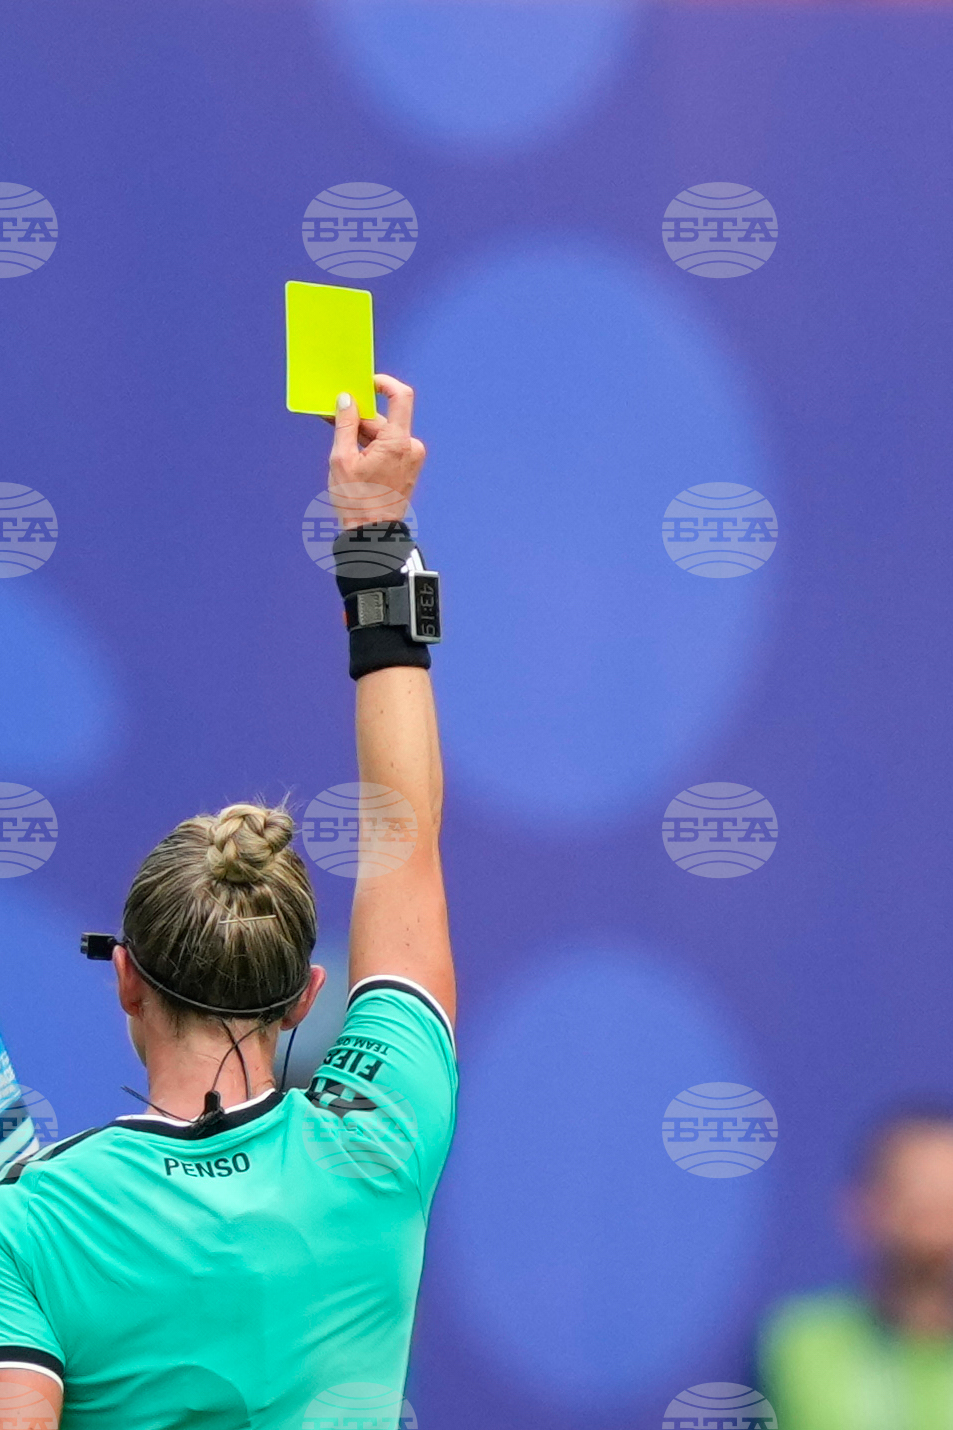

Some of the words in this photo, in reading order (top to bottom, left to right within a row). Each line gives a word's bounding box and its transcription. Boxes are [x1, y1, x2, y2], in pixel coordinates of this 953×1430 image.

[419, 583, 436, 637] 43:19
[354, 1038, 389, 1056] TEAM
[164, 1152, 251, 1178] PENSO
